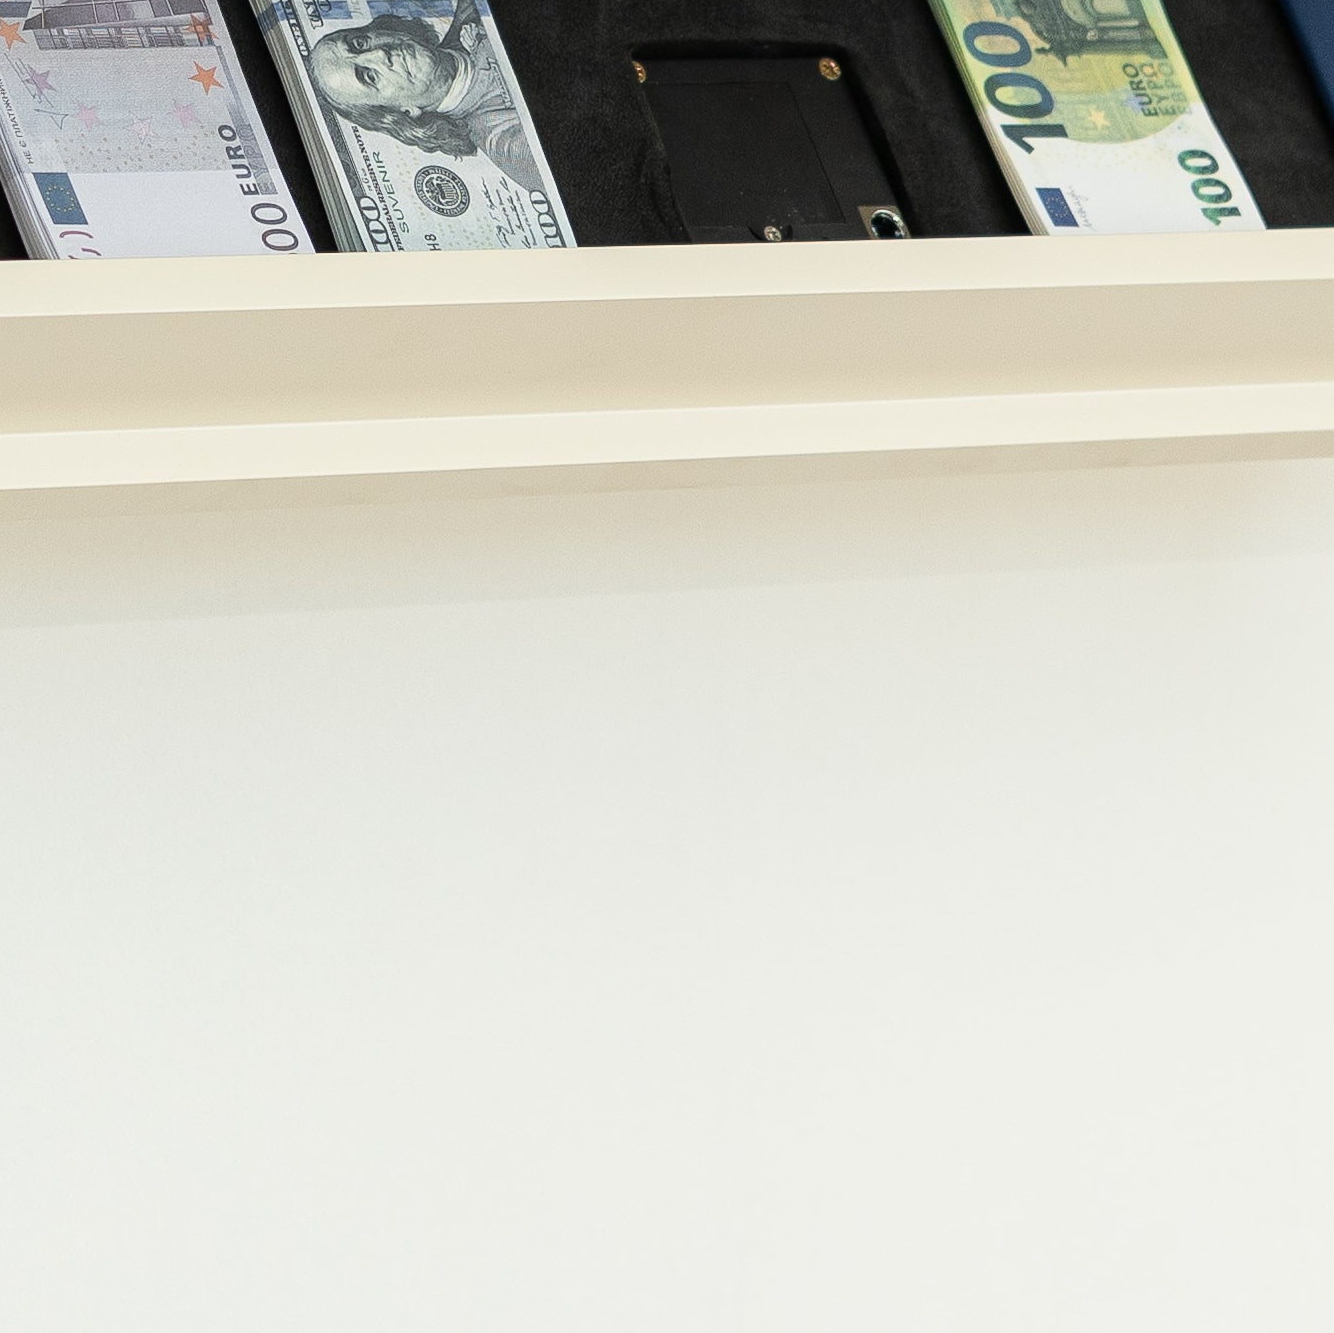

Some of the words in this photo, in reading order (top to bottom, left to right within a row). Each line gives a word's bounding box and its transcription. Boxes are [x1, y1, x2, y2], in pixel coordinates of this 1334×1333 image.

[962, 20, 1069, 155] 100
[1122, 62, 1160, 118] EURO
[217, 123, 261, 197] EURO
[370, 150, 410, 233] SUVENIR
[1177, 149, 1242, 227] 100
[250, 202, 299, 254] 00
